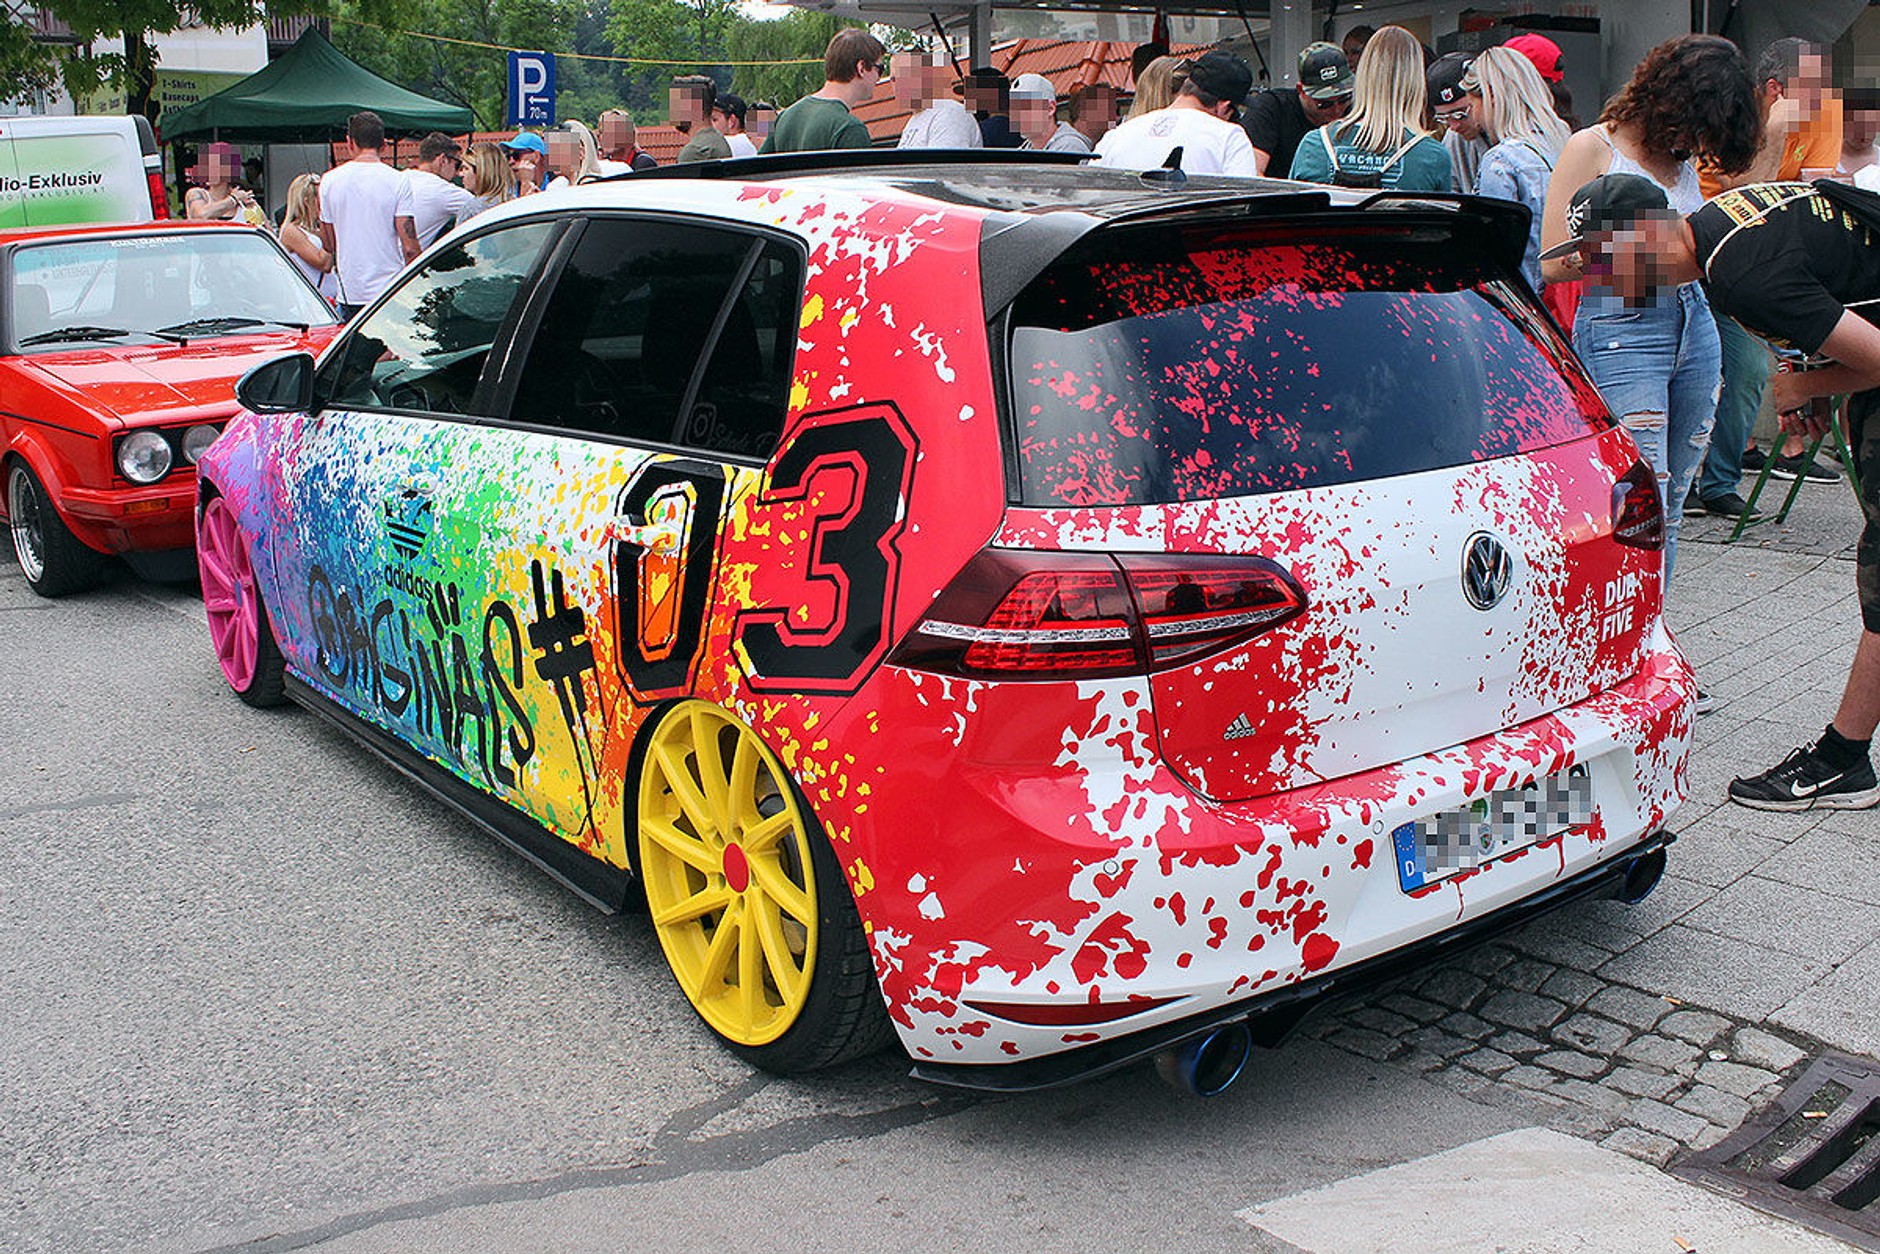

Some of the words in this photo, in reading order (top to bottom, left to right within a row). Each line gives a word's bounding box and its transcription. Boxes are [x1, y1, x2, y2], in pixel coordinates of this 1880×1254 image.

[518, 58, 546, 119] P
[384, 563, 433, 602] adidas
[1601, 605, 1634, 642] FIVE
